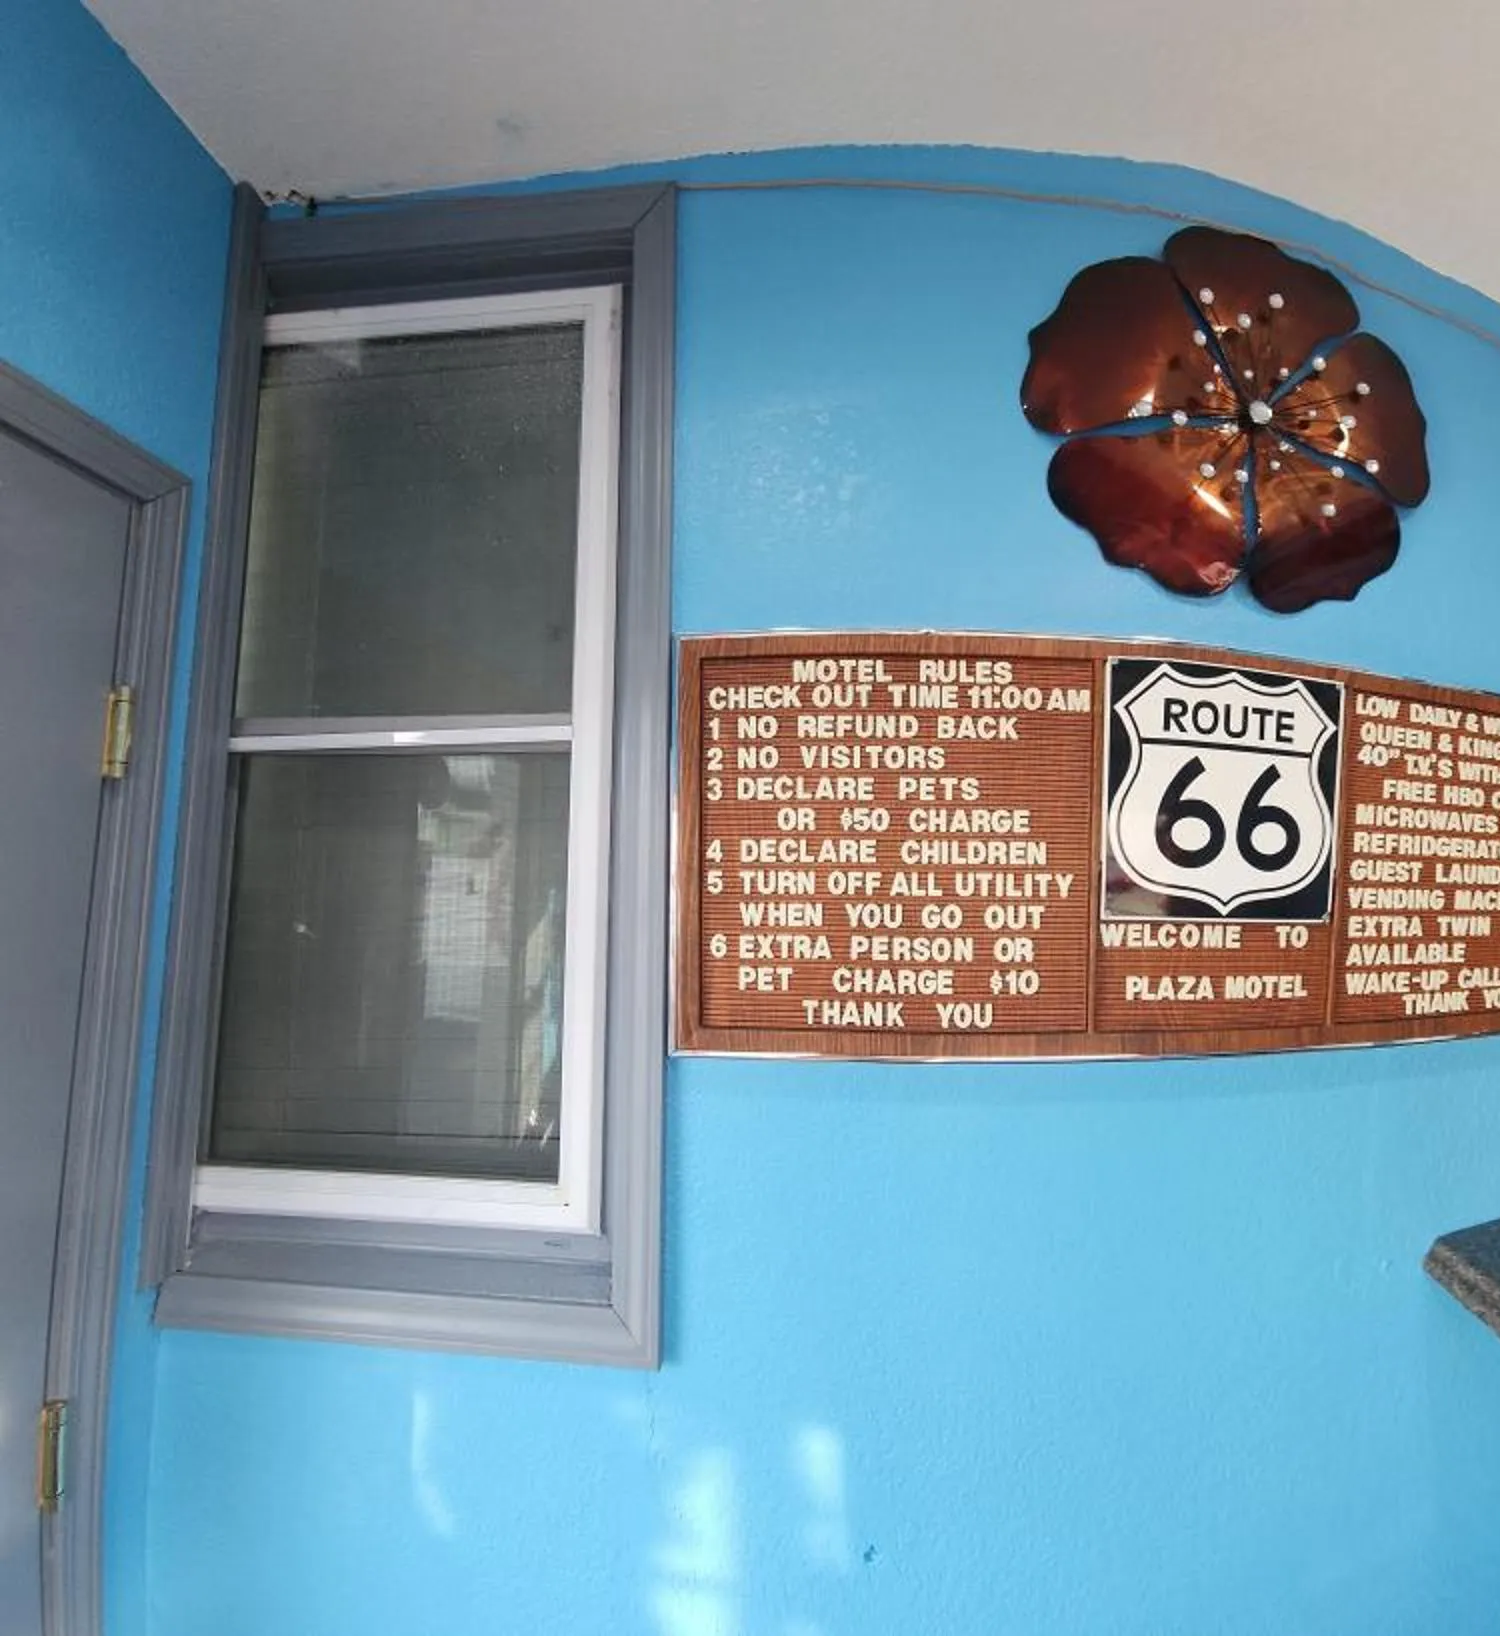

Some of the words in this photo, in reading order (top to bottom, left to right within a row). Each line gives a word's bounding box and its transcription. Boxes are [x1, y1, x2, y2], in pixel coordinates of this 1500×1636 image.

[792, 659, 893, 684] MOTEL
[919, 659, 1014, 684] RULES
[709, 685, 801, 711] CHECK
[812, 684, 872, 708] OUT
[888, 686, 959, 709] TIME
[968, 686, 1043, 711] 11:00
[1047, 688, 1091, 713] AM
[1163, 698, 1295, 744] ROUTE
[1356, 694, 1400, 718] LOW
[1409, 703, 1462, 728] DAILY
[1465, 713, 1479, 732] &
[707, 717, 721, 740] 1
[737, 715, 778, 739] NO
[797, 715, 919, 739] REFUND
[937, 717, 1020, 741] BACK
[1361, 721, 1432, 750] QUEEN
[1438, 733, 1452, 753] &
[706, 747, 724, 771] 2
[737, 746, 779, 770] NO
[801, 746, 946, 770] VISITORS
[706, 778, 724, 801] 3
[737, 777, 876, 801] DECLARE
[899, 777, 981, 801] PETS
[1383, 779, 1437, 803] FREE
[1444, 786, 1485, 807] HBO
[777, 808, 816, 832] OR
[841, 808, 890, 832] $50
[909, 809, 1031, 834] CHARGE
[1155, 755, 1301, 872] 66
[1355, 804, 1499, 834] MICROWAVES
[706, 840, 724, 864] 4
[739, 840, 878, 864] DECLARE
[900, 841, 1048, 866] CHILDREN
[1350, 859, 1422, 883] GUEST
[707, 871, 724, 895] 5
[739, 871, 816, 895] TURN
[827, 871, 882, 895] OFF
[890, 872, 943, 897] ALL
[955, 873, 1074, 898] UTILITY
[1348, 888, 1445, 909] VENDING
[739, 902, 823, 928] WHEN
[846, 904, 903, 929] YOU
[922, 904, 963, 929] GO
[984, 905, 1045, 930] OUT
[1348, 916, 1422, 938] EXTRA
[1437, 916, 1490, 936] TWIN
[710, 935, 727, 959] 6
[739, 935, 832, 960] EXTRA
[850, 937, 974, 962] PERSON
[994, 937, 1034, 963] OR
[1100, 923, 1242, 949] WELCOME
[1275, 925, 1309, 949] TO
[1346, 942, 1466, 966] AVAILABLE
[739, 966, 793, 992] PET
[833, 968, 955, 995] CHARGE
[990, 970, 1040, 996] $10
[1125, 975, 1214, 1002] PLAZA
[1224, 974, 1307, 999] MOTEL
[1346, 970, 1449, 994] WAKE-UP
[803, 1000, 905, 1028] THANK
[937, 1003, 994, 1029] YOU
[1403, 991, 1468, 1016] THANK
